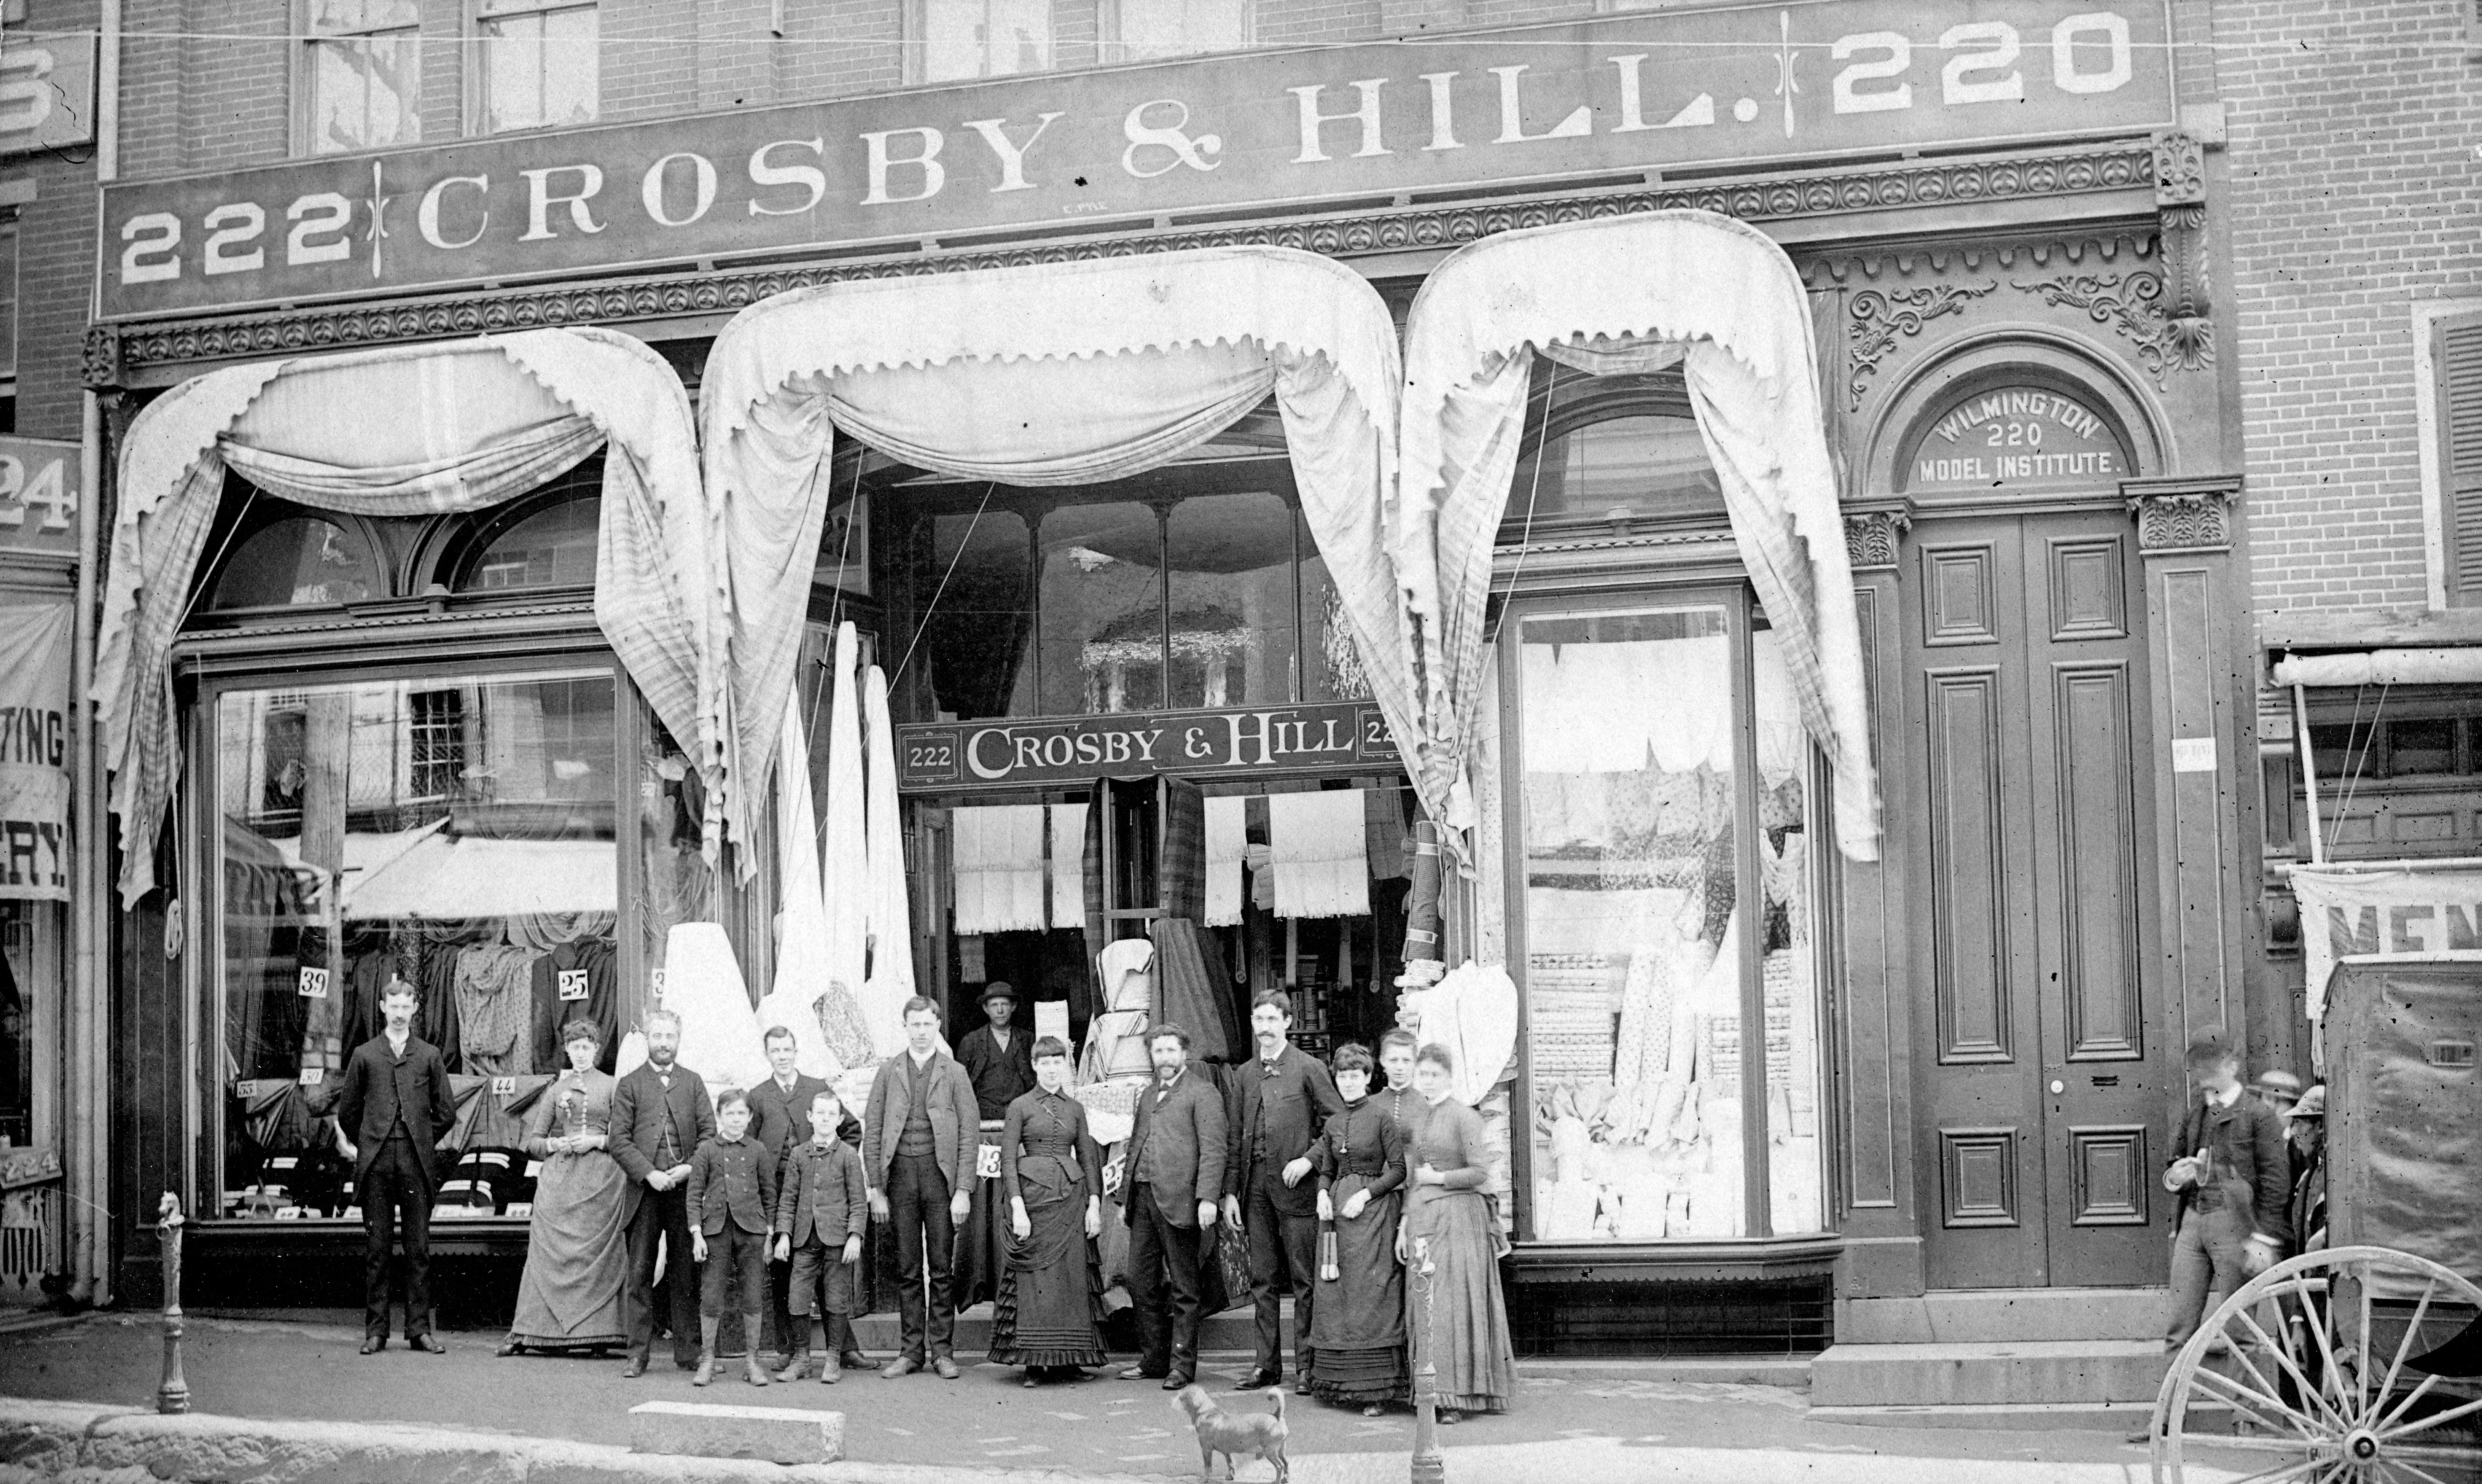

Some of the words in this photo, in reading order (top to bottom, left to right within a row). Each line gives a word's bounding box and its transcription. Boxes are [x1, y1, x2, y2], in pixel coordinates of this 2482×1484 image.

[122, 193, 351, 284] 222
[419, 110, 1066, 249] CROSBY
[1122, 99, 1222, 178] &
[1286, 54, 1759, 164] HILL.
[1831, 12, 2132, 114] 220
[1936, 392, 2100, 443] WILMINGTON
[1987, 422, 2042, 447] 220
[1919, 457, 1990, 482] MODEL
[1996, 452, 2122, 478] INSTITUTE.
[910, 746, 951, 767] 222
[967, 727, 1164, 779] CROSBY
[1184, 727, 1213, 758] &
[1218, 712, 1356, 766] HILL
[302, 971, 325, 994] 39
[562, 974, 586, 997] 25
[239, 1084, 253, 1095] 55
[302, 1071, 319, 1082] 50
[3, 1152, 59, 1183] 224
